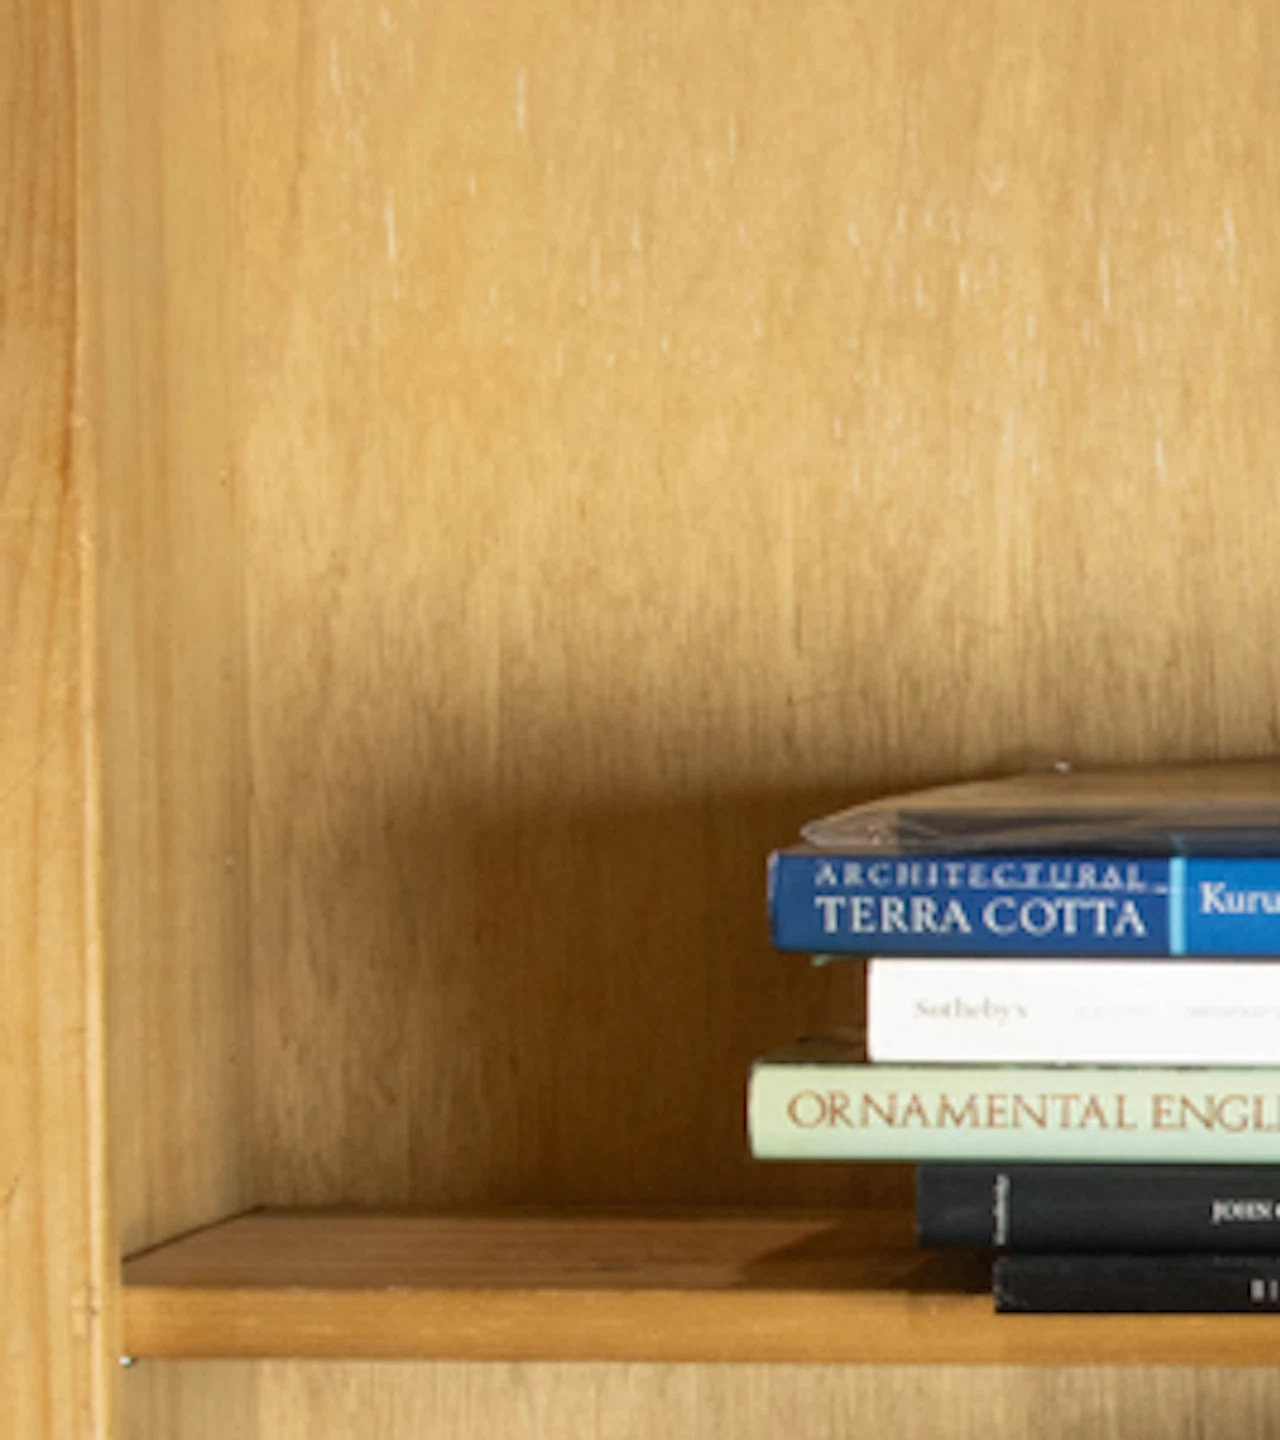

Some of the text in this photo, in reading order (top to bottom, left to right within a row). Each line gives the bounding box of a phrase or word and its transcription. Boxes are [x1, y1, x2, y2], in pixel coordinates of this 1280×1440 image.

[815, 895, 1147, 937] TERRA COTTA
[788, 1090, 1137, 1132] ORNAMENTAL
[1211, 1200, 1269, 1222] JOHN
